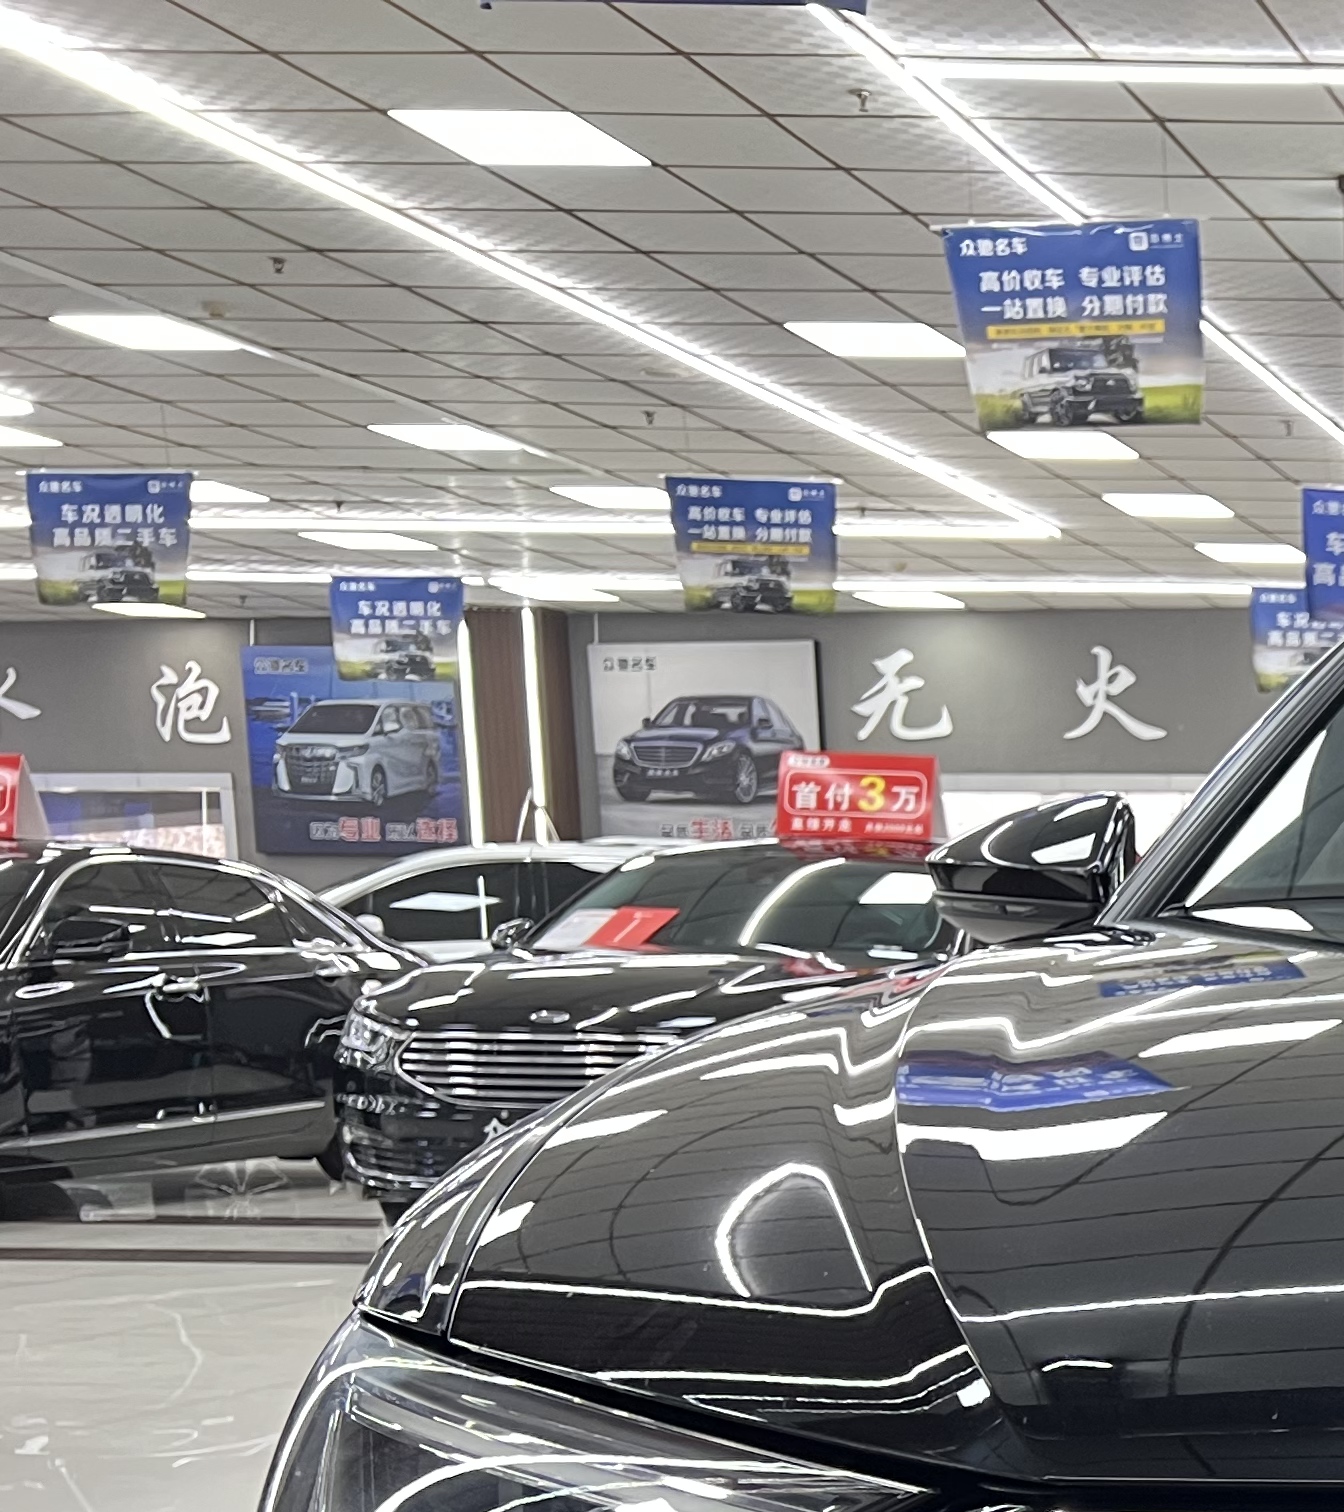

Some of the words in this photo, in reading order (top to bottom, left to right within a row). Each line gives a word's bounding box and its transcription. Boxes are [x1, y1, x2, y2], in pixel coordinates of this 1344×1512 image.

[978, 268, 1066, 294] 高价收车
[1077, 264, 1167, 288] 专业评估
[1081, 292, 1169, 317] 分期付款
[60, 503, 165, 524] 车况透明化
[52, 527, 178, 547] 高品质二手车
[791, 775, 920, 812] 首付3万
